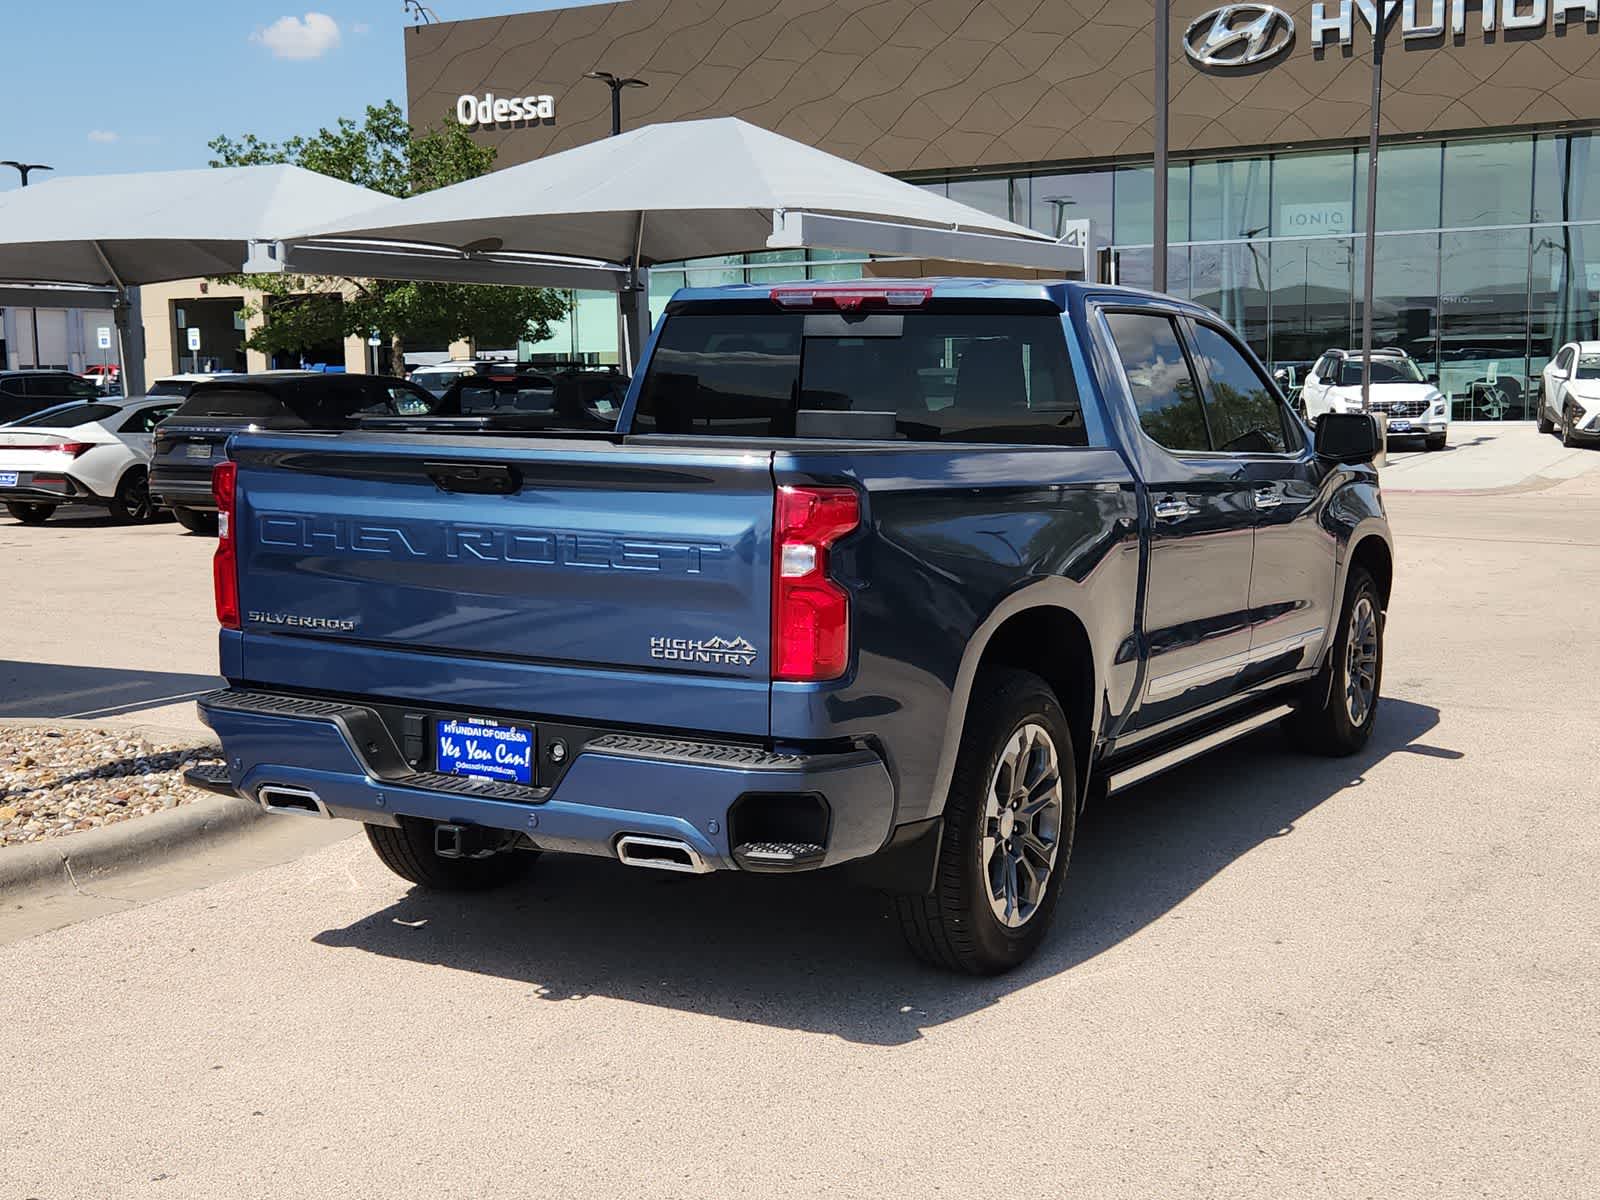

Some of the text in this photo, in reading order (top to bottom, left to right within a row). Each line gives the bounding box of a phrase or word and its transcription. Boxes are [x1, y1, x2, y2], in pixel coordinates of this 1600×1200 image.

[457, 93, 554, 125] Odessa
[1289, 211, 1343, 225] IONIQ
[258, 513, 727, 574] CHEVROLET
[248, 610, 355, 631] SILVERADO
[651, 637, 702, 650] HIGH
[651, 648, 757, 665] COUNTRY
[444, 724, 527, 742] HYUNDAI OF ODESSA
[441, 736, 531, 767] Yes You Can!
